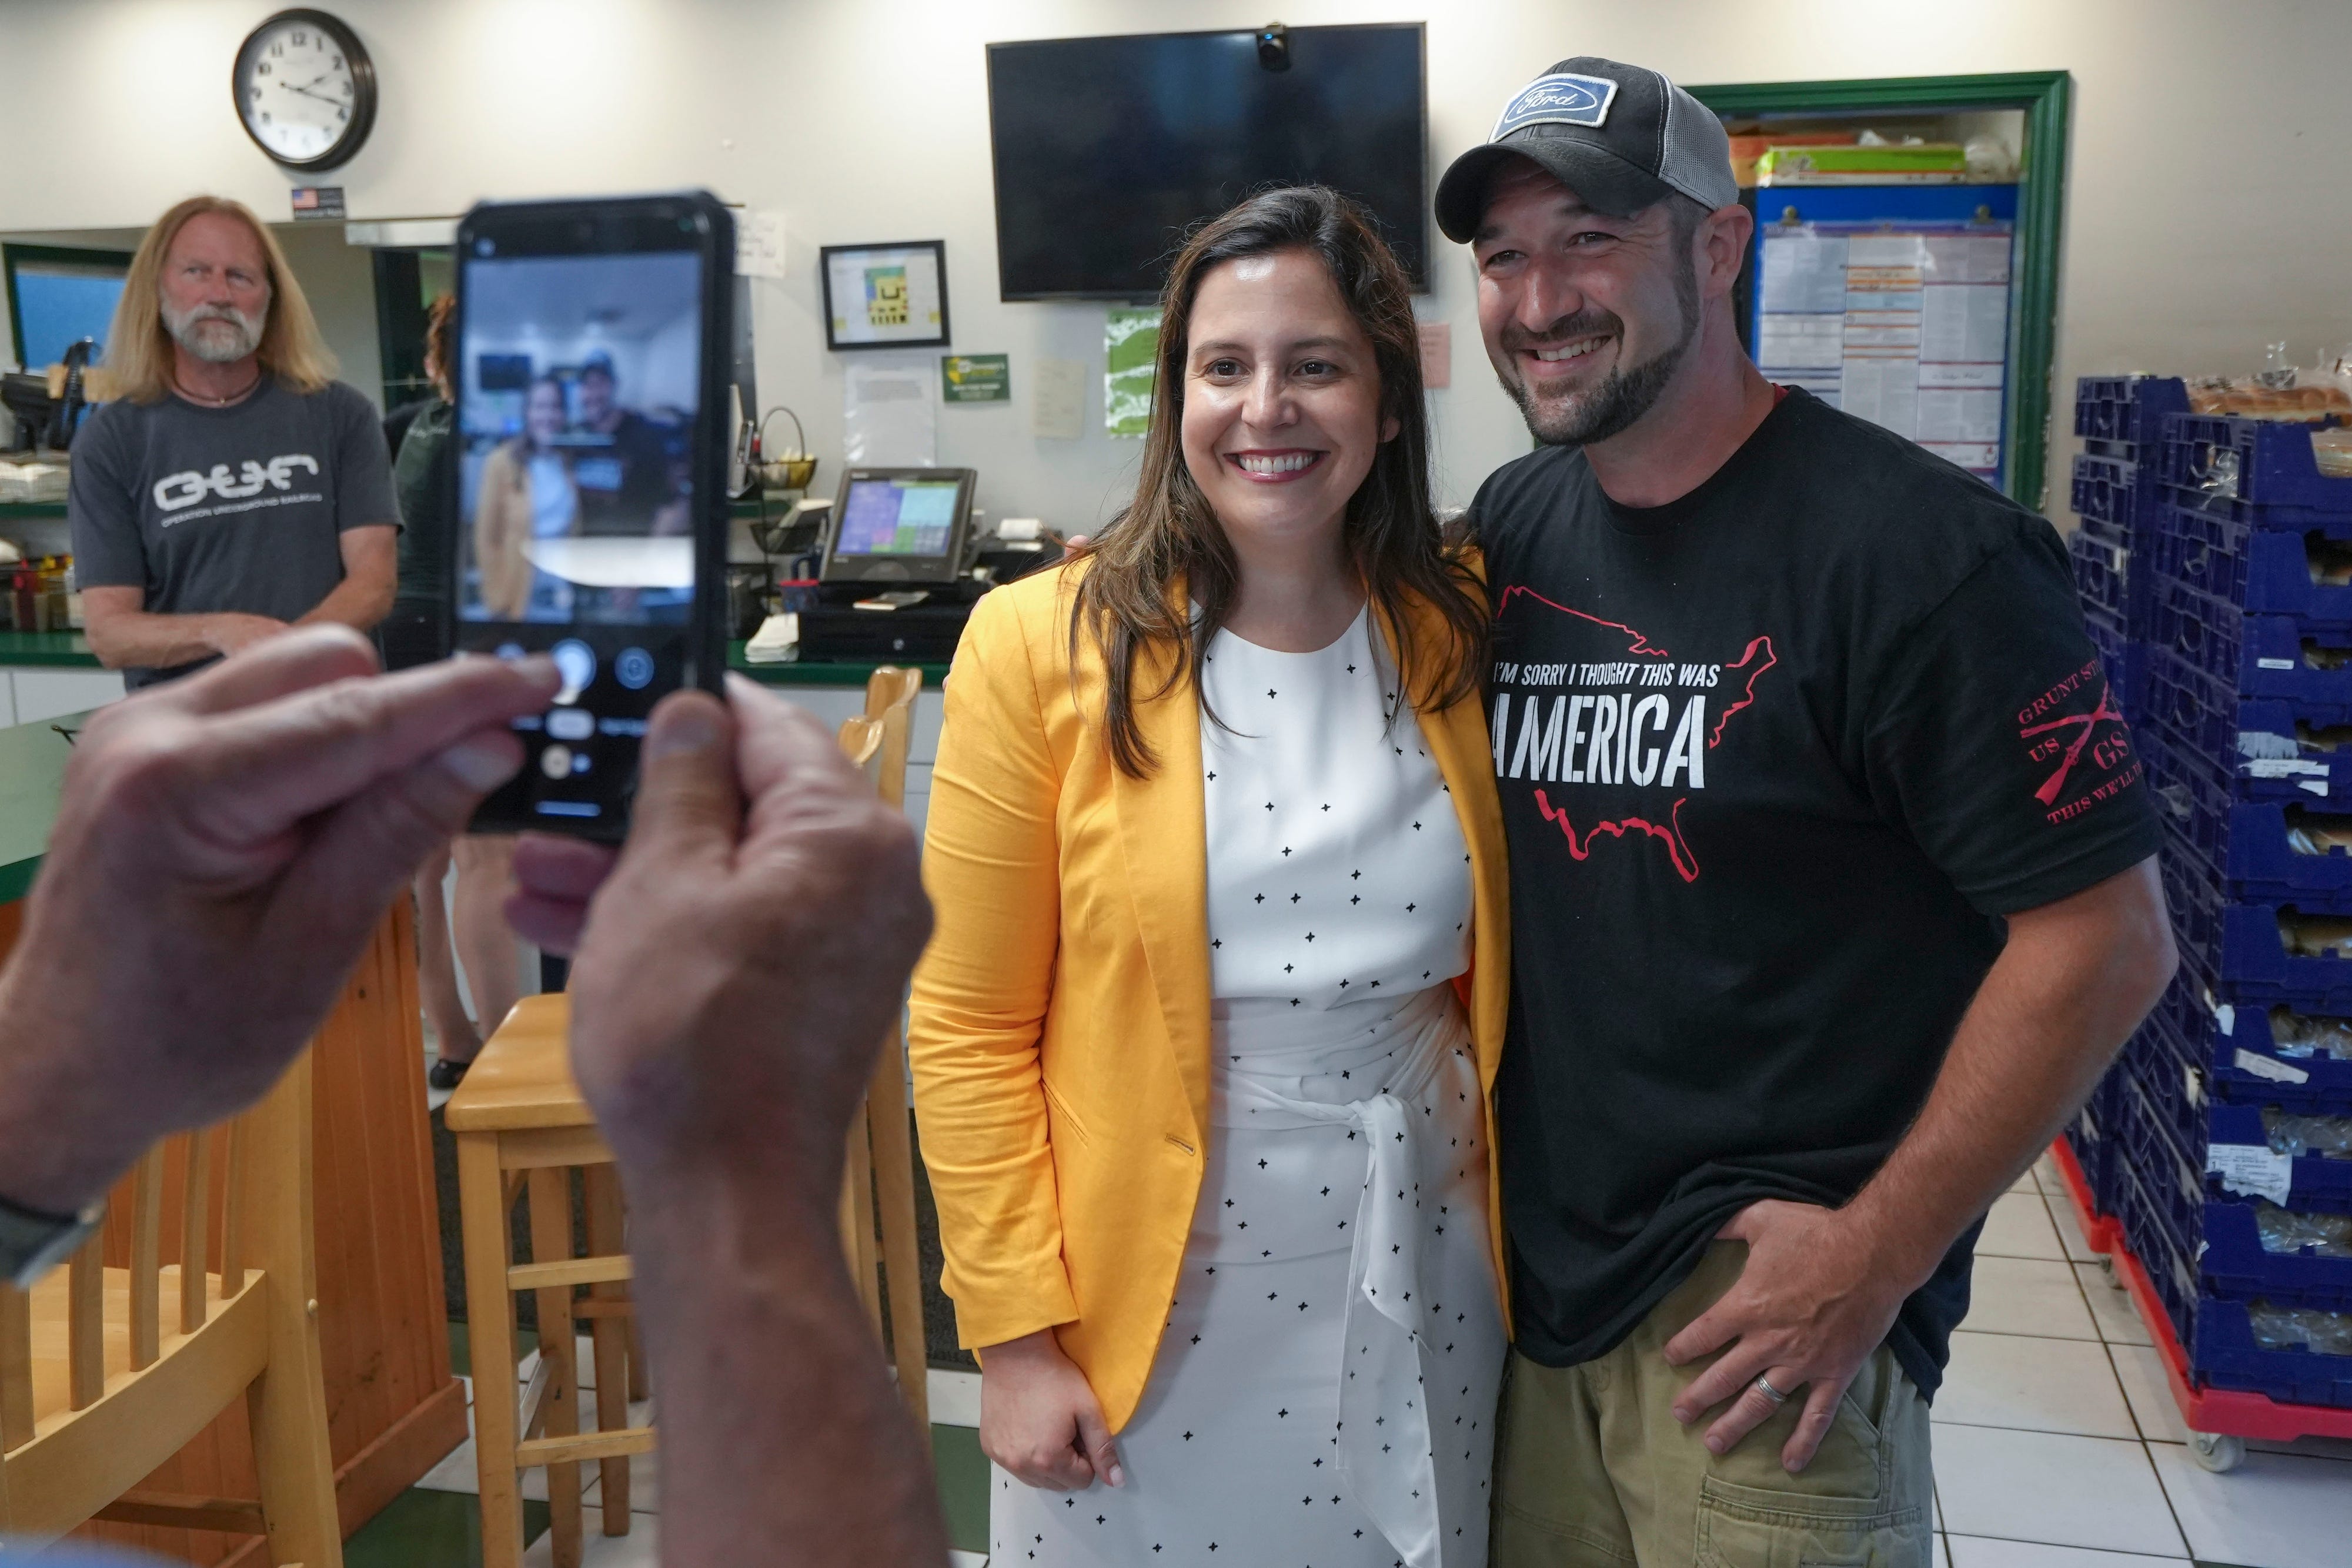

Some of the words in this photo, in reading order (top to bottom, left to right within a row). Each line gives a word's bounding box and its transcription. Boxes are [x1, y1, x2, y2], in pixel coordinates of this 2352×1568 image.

[271, 42, 283, 57] 11
[292, 32, 306, 47] 12
[316, 37, 322, 52] 1
[258, 62, 272, 75] 10
[333, 55, 342, 71] 2
[1516, 88, 1578, 114] Ford
[1494, 662, 1519, 684] I'M
[1521, 664, 1567, 686] SORRY
[1568, 663, 1577, 686] I
[1579, 662, 1640, 686] THOUGHT
[1639, 663, 1675, 687] THIS
[1678, 664, 1721, 688] WAS
[2018, 673, 2080, 724] GRUNT
[1492, 693, 1706, 788] AMERICA
[2029, 737, 2060, 763] US
[2093, 731, 2129, 770] GS
[2047, 796, 2093, 824] THIS
[2092, 771, 2135, 801] WE'LL
